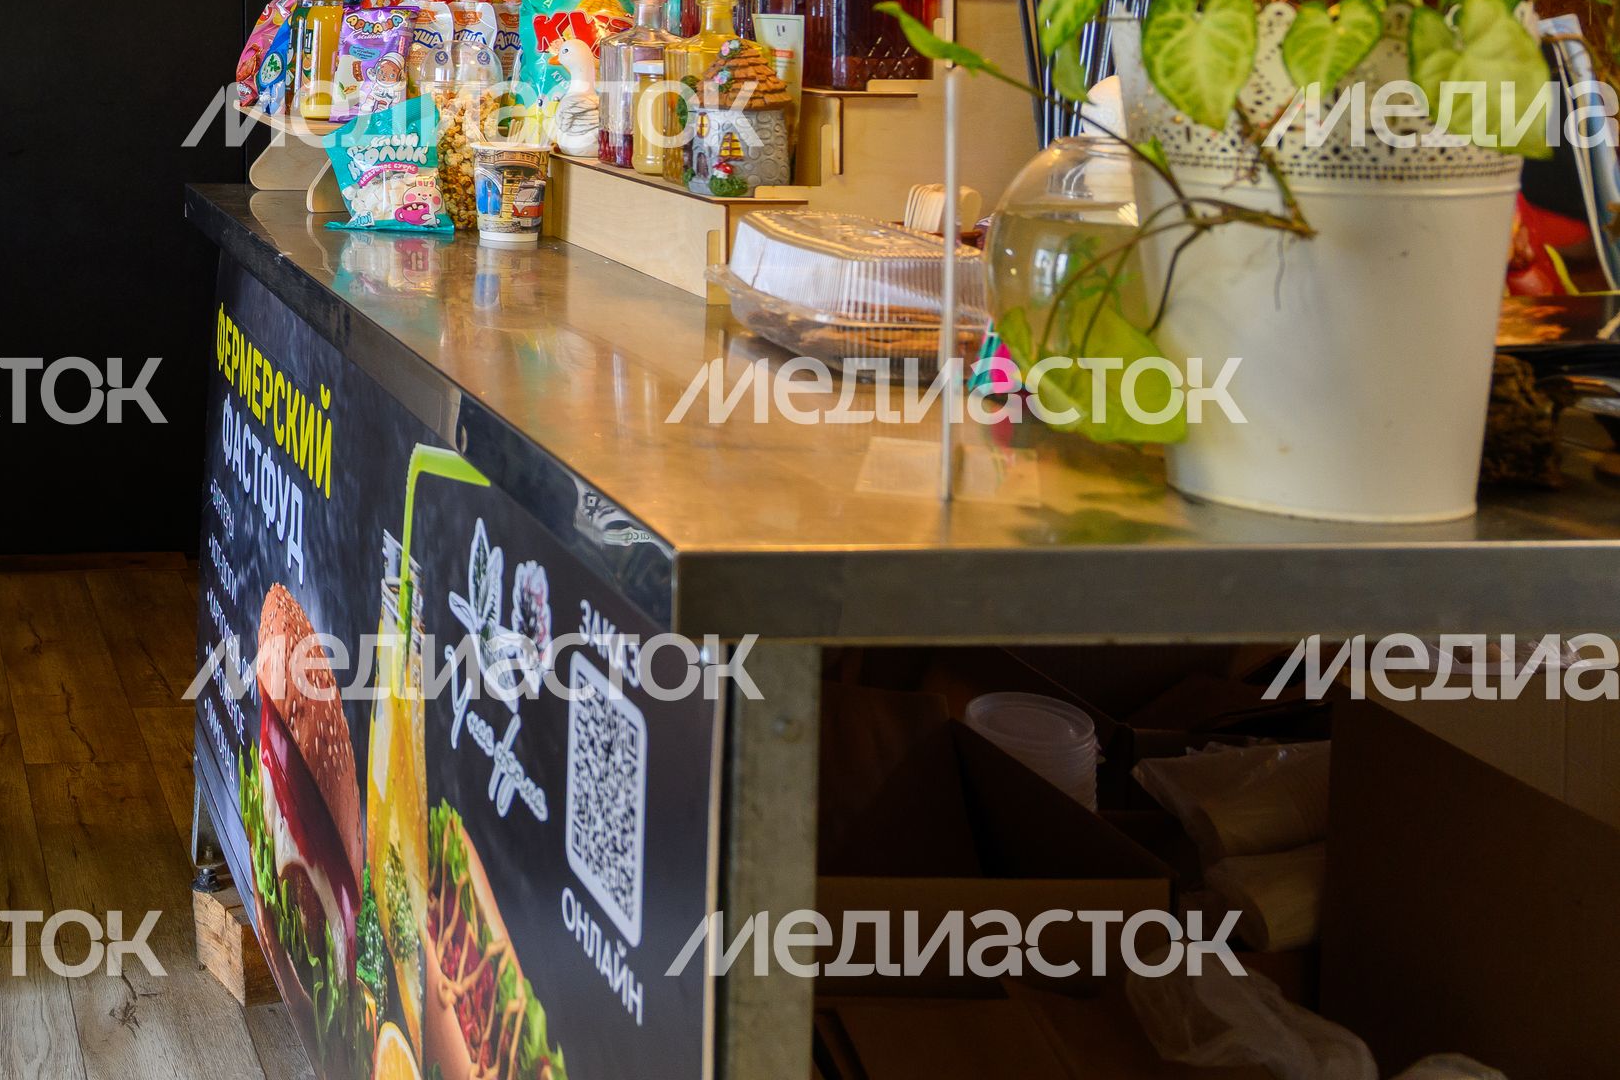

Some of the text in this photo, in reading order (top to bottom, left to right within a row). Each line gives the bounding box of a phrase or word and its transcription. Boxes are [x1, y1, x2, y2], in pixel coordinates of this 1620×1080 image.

[217, 302, 332, 500] ФЕРМЕРСКИЙ
[222, 393, 304, 585] ФАСТФУД
[579, 599, 641, 688] ЗАКАЗ
[561, 887, 643, 1025] ОНЛАЙН
